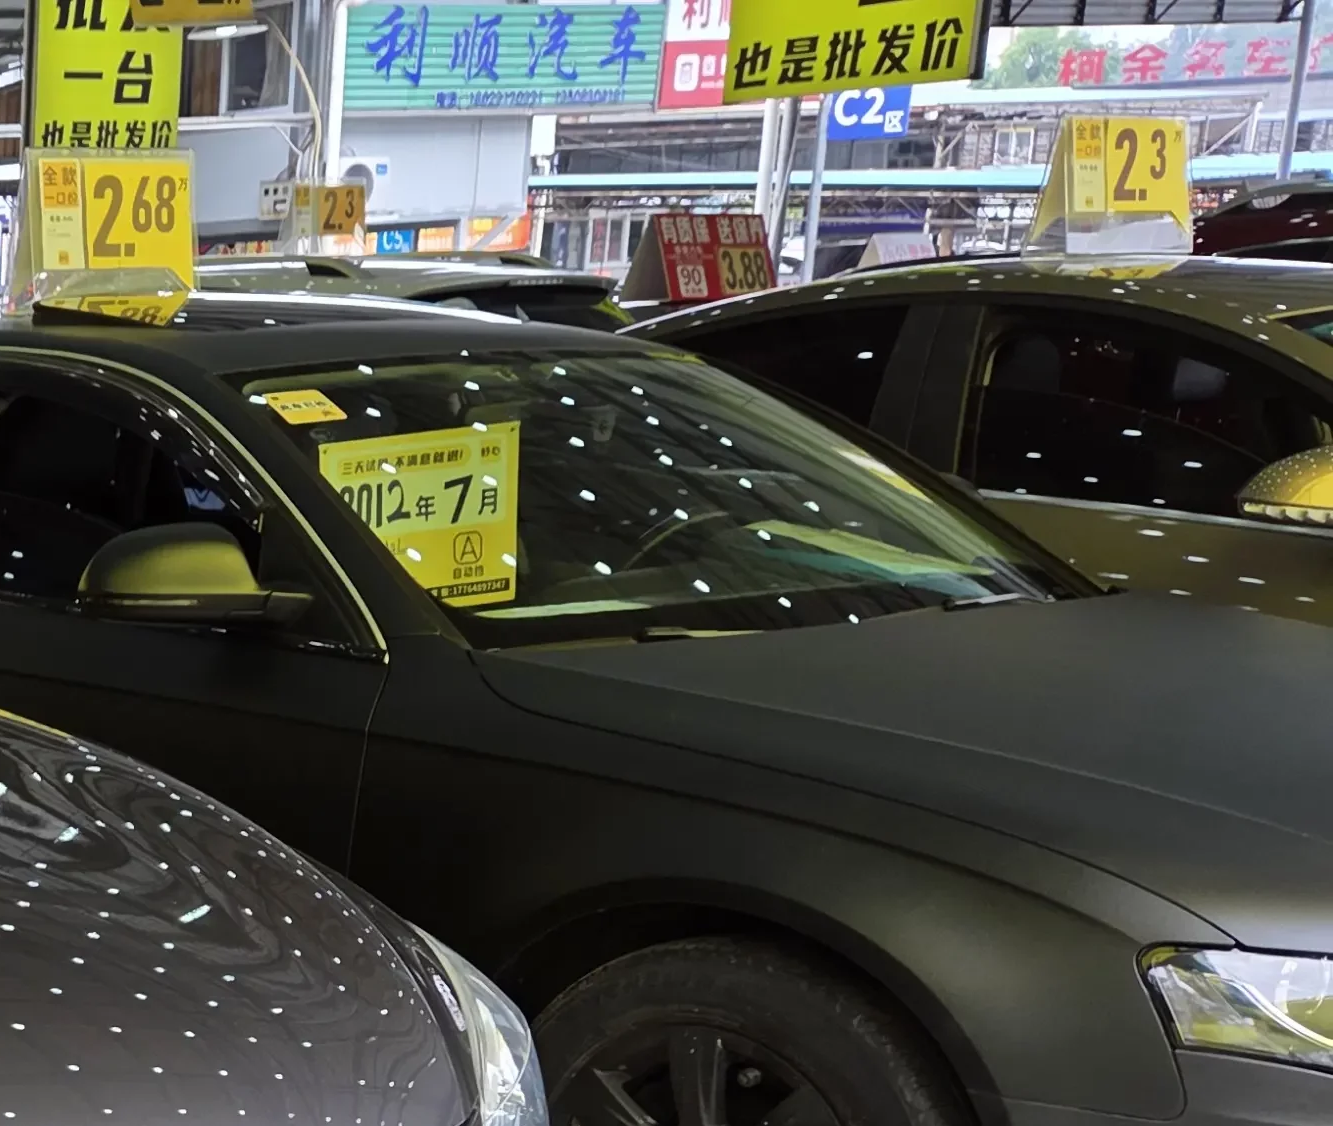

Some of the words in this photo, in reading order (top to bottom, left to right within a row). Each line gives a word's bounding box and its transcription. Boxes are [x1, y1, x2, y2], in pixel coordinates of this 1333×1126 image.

[366, 5, 646, 87] 利顺汽车
[733, 17, 964, 90] 也是批发价
[64, 50, 153, 104] 一台
[41, 119, 172, 148] 也是批发价
[834, 88, 905, 133] C2区
[721, 250, 768, 290] 3.88
